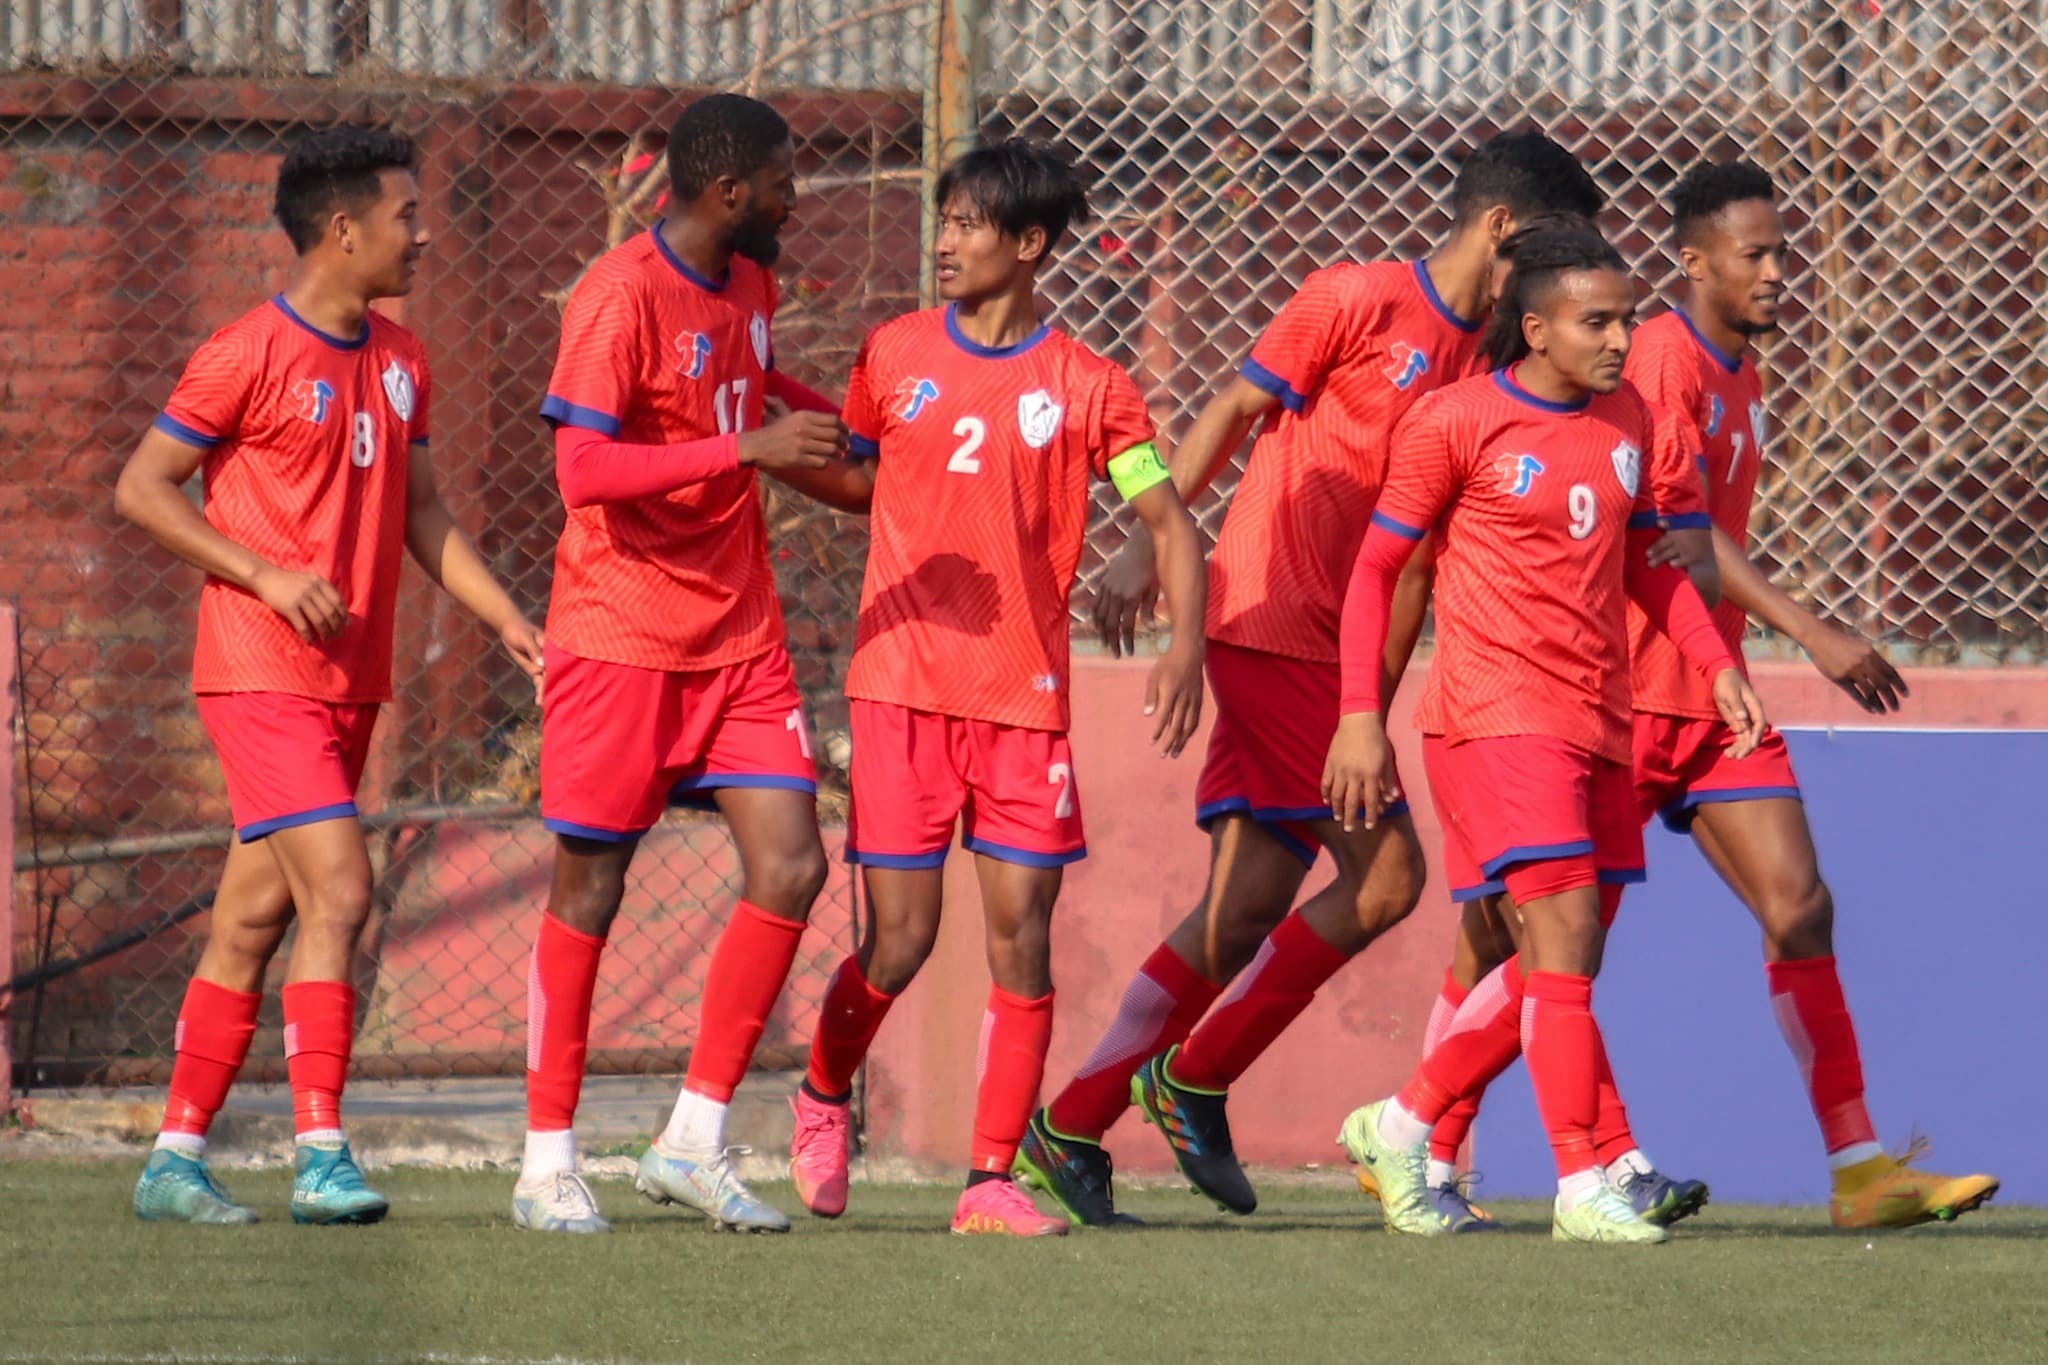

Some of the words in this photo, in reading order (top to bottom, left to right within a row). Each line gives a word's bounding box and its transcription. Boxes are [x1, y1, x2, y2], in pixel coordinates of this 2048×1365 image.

[713, 377, 748, 435] 17
[351, 412, 376, 467] 8
[946, 416, 985, 475] 2
[1725, 432, 1743, 485] 7
[1568, 484, 1596, 540] 9
[1048, 762, 1073, 820] 2
